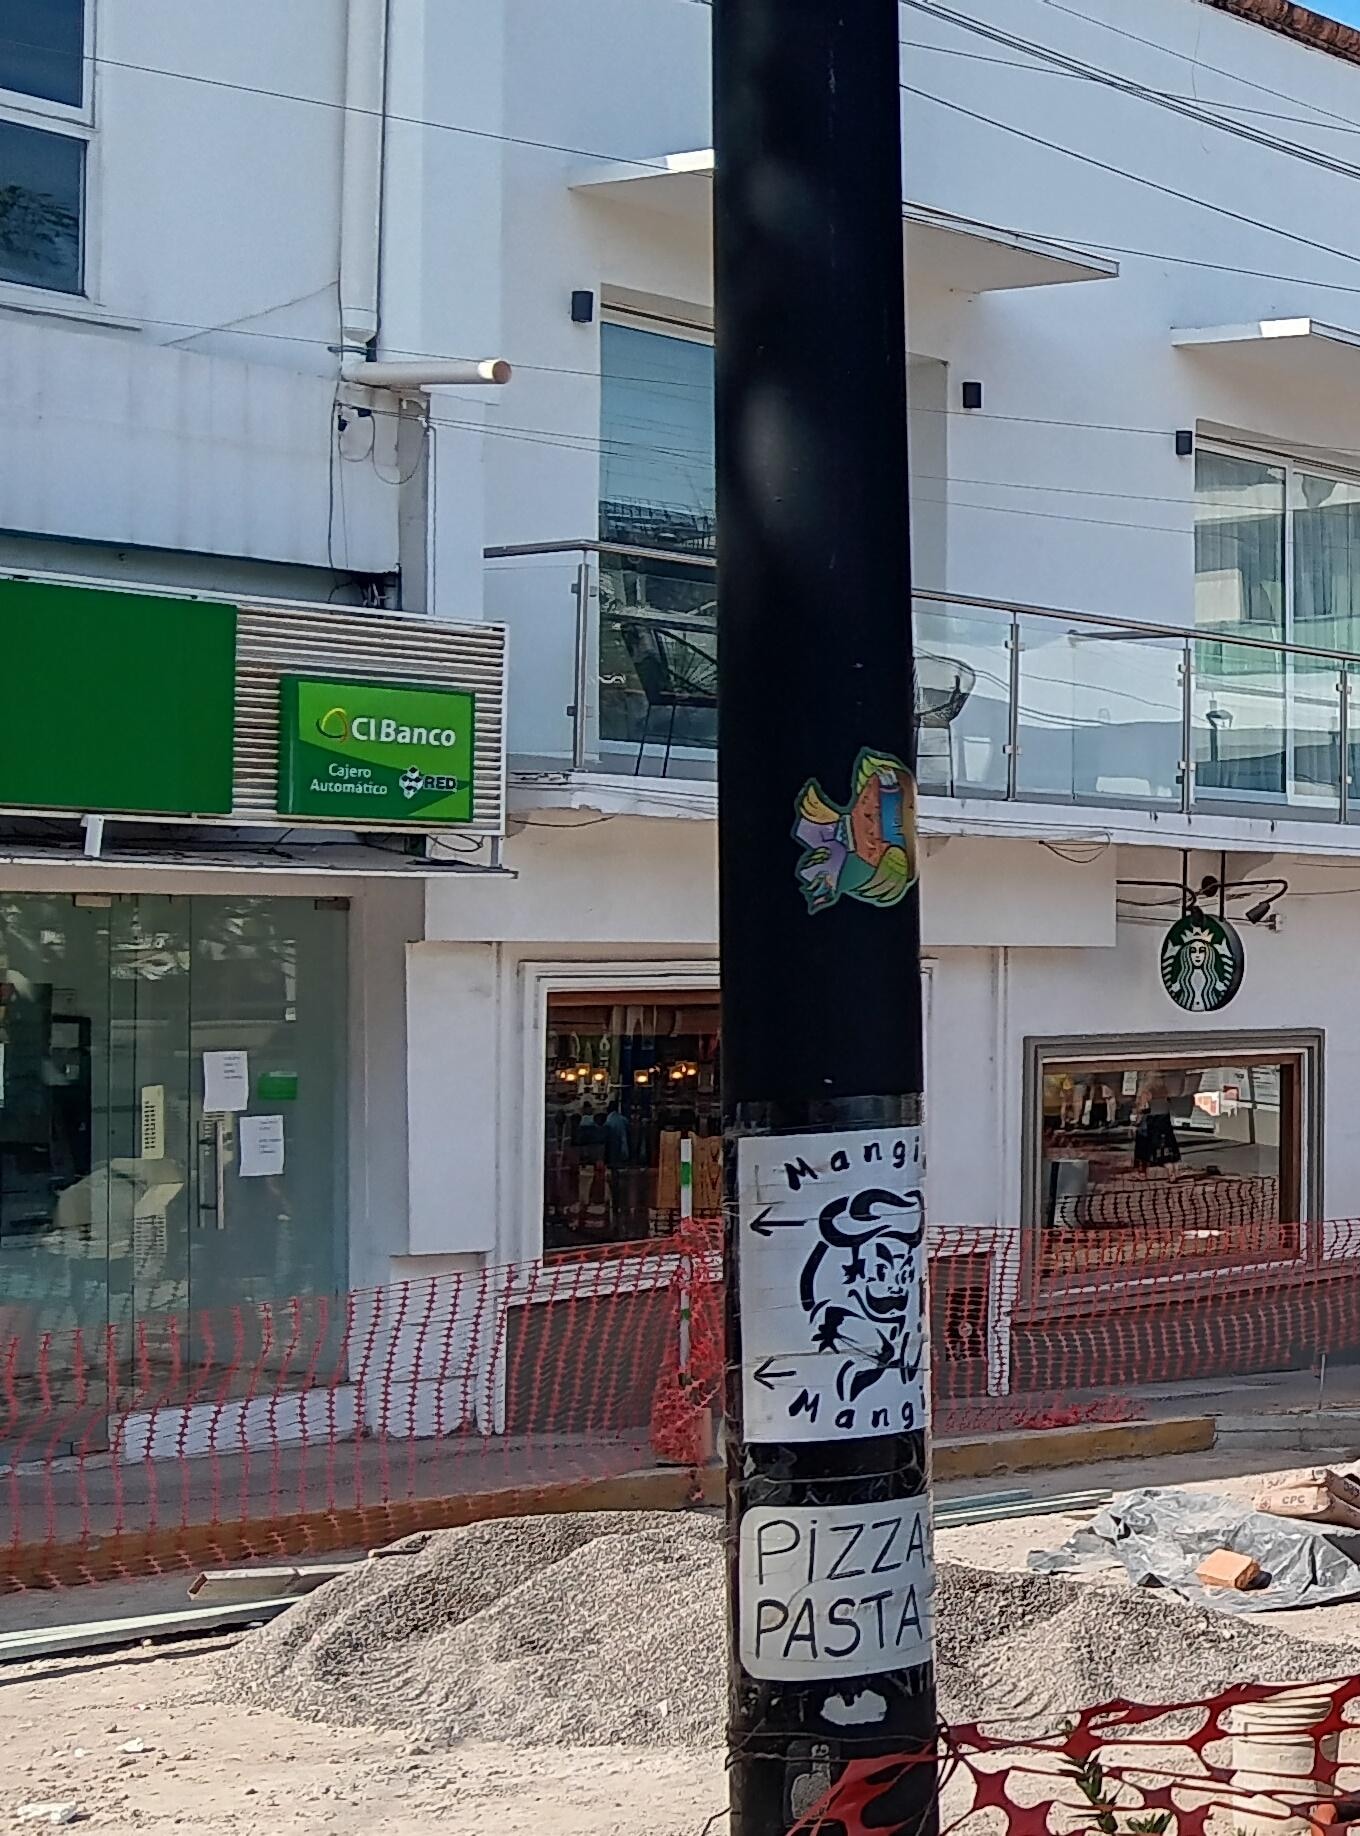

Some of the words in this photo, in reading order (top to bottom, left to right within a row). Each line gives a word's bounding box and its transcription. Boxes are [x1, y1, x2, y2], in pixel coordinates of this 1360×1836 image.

[328, 762, 372, 778] Cajero
[310, 778, 388, 795] Automático
[424, 775, 458, 791] RED
[784, 1135, 926, 1191] Mangi
[755, 1584, 923, 1659] PASTA
